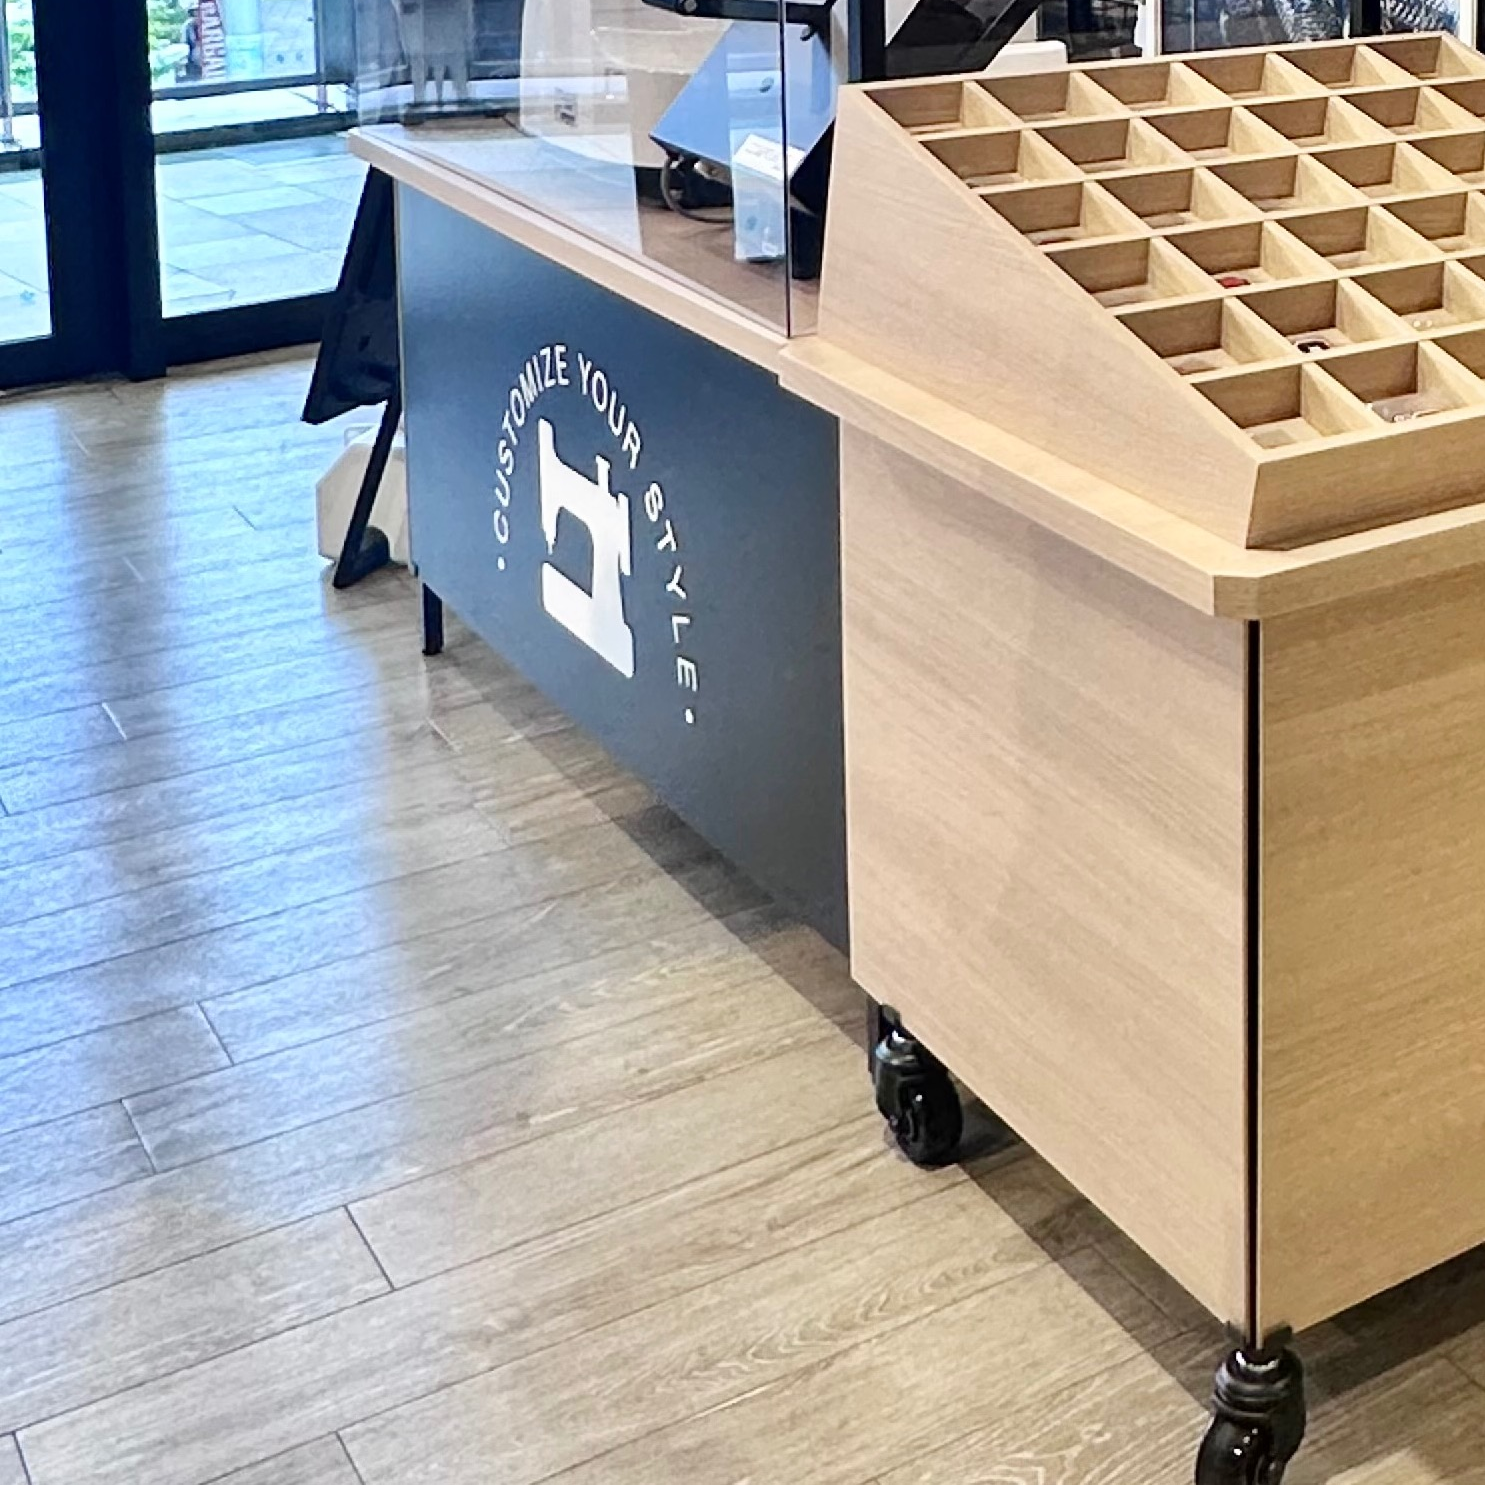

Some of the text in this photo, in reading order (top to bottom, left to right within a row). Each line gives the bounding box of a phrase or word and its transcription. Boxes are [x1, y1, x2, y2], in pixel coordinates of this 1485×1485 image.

[493, 344, 699, 693] CUSTOMIZE YOUR STYLE
